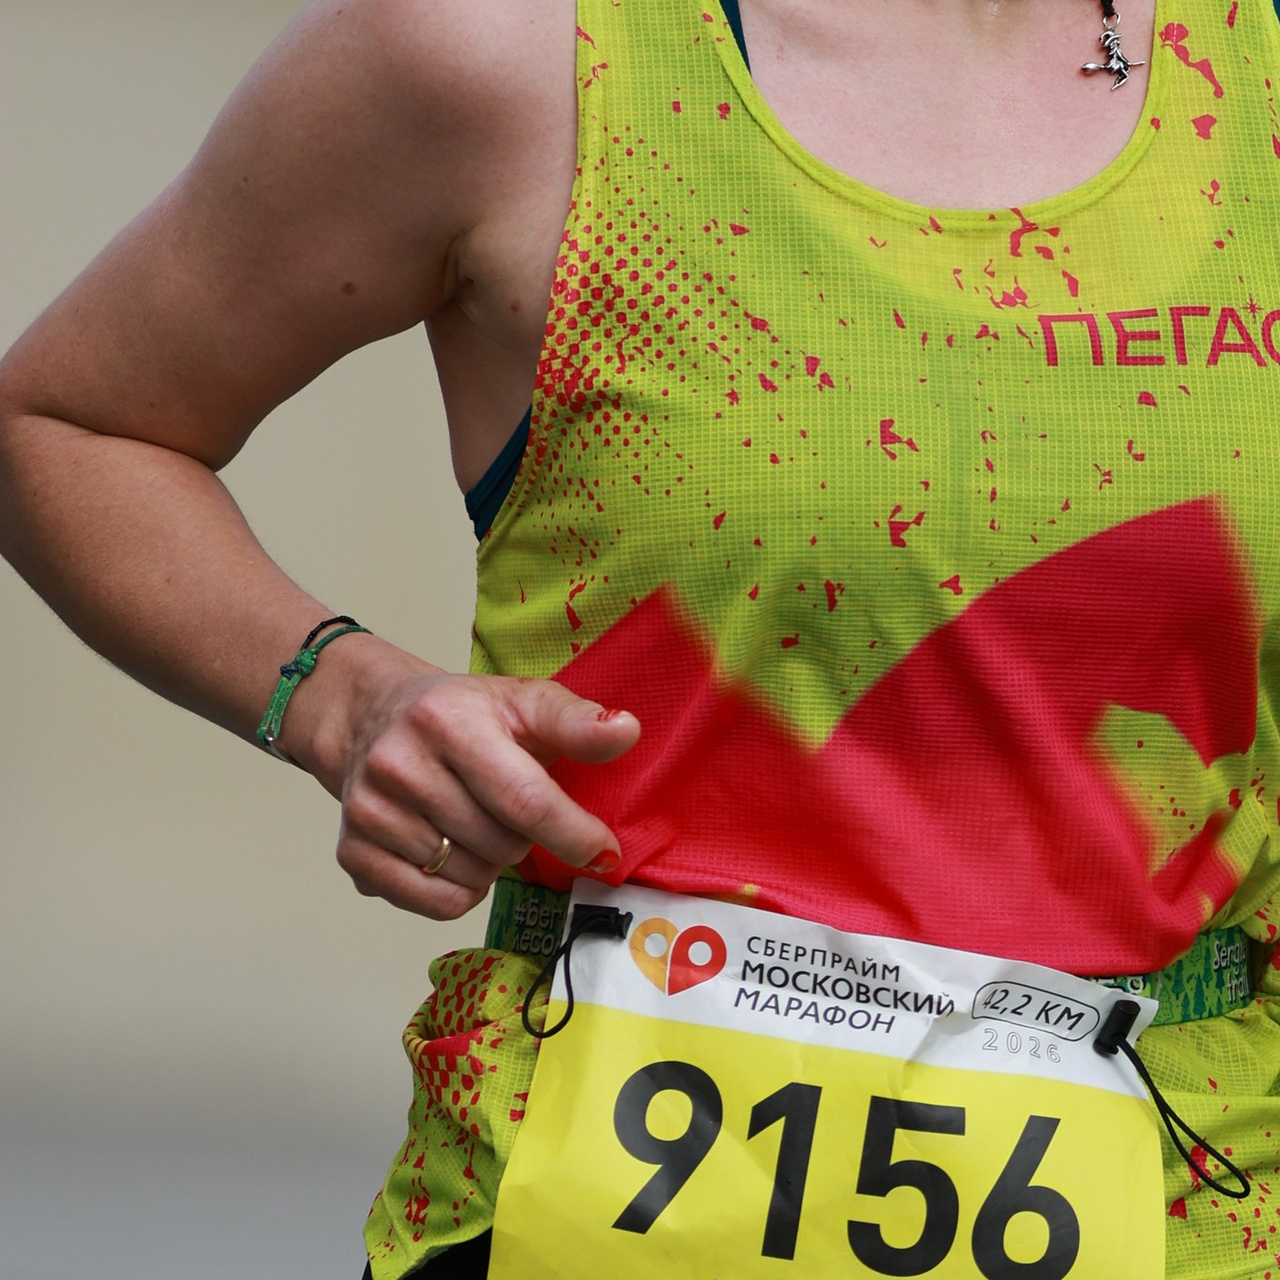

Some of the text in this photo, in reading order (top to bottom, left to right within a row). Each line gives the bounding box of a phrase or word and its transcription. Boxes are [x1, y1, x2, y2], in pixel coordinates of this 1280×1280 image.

[746, 936, 900, 983] СБЕРПРАЙМ
[733, 987, 896, 1034] МАРАФОН
[741, 960, 955, 1017] МОСКОВСКИЙ
[982, 988, 1033, 1016] 42,2
[981, 1027, 1061, 1064] 2026
